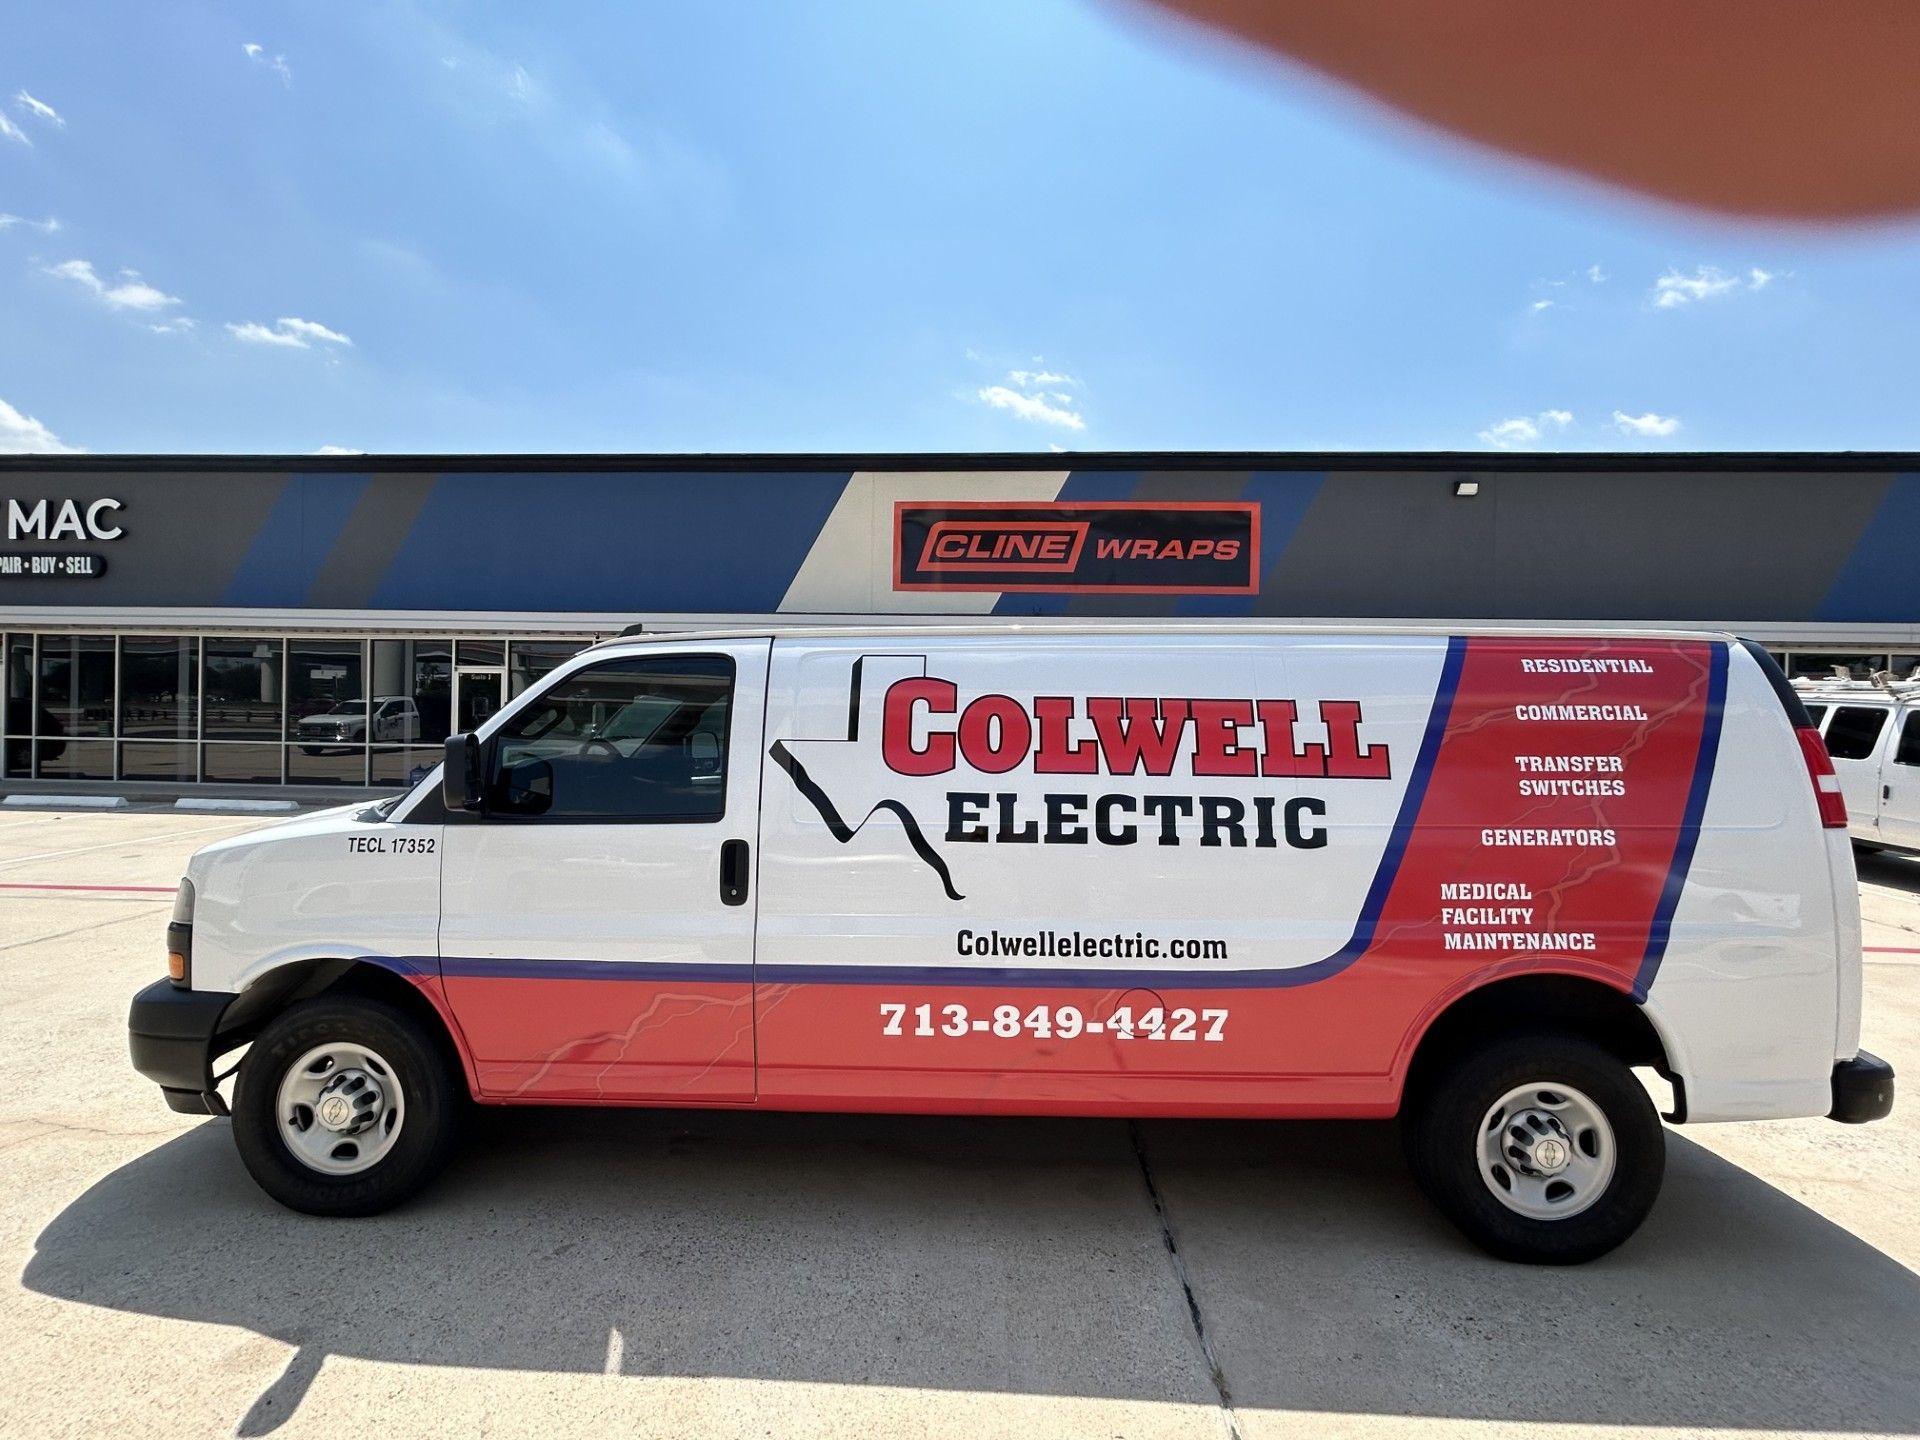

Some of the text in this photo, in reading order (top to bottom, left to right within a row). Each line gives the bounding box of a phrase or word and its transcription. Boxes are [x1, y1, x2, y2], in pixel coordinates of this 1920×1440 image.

[8, 498, 122, 540] MAC
[935, 534, 1240, 561] CLINE WRAPS
[31, 556, 56, 574] BUY
[66, 556, 93, 574] SELL
[1519, 658, 1655, 674] RESIDENTIAL
[1515, 703, 1648, 722] COMMERCIAL
[882, 676, 1392, 780] COLWELL
[1514, 755, 1624, 773] TRANSFER
[1518, 779, 1626, 797] SWITCHES
[944, 791, 1328, 849] ELECTRIC
[348, 837, 436, 854] TECL 17352
[1481, 828, 1617, 848] GENERATORS
[1440, 883, 1533, 901] MEDICAL
[1441, 907, 1534, 926] FACILITY
[957, 929, 1228, 959] Colwellelectric.com
[1443, 932, 1597, 951] MAINTENANCE
[880, 1003, 1229, 1042] 713-849-4427
